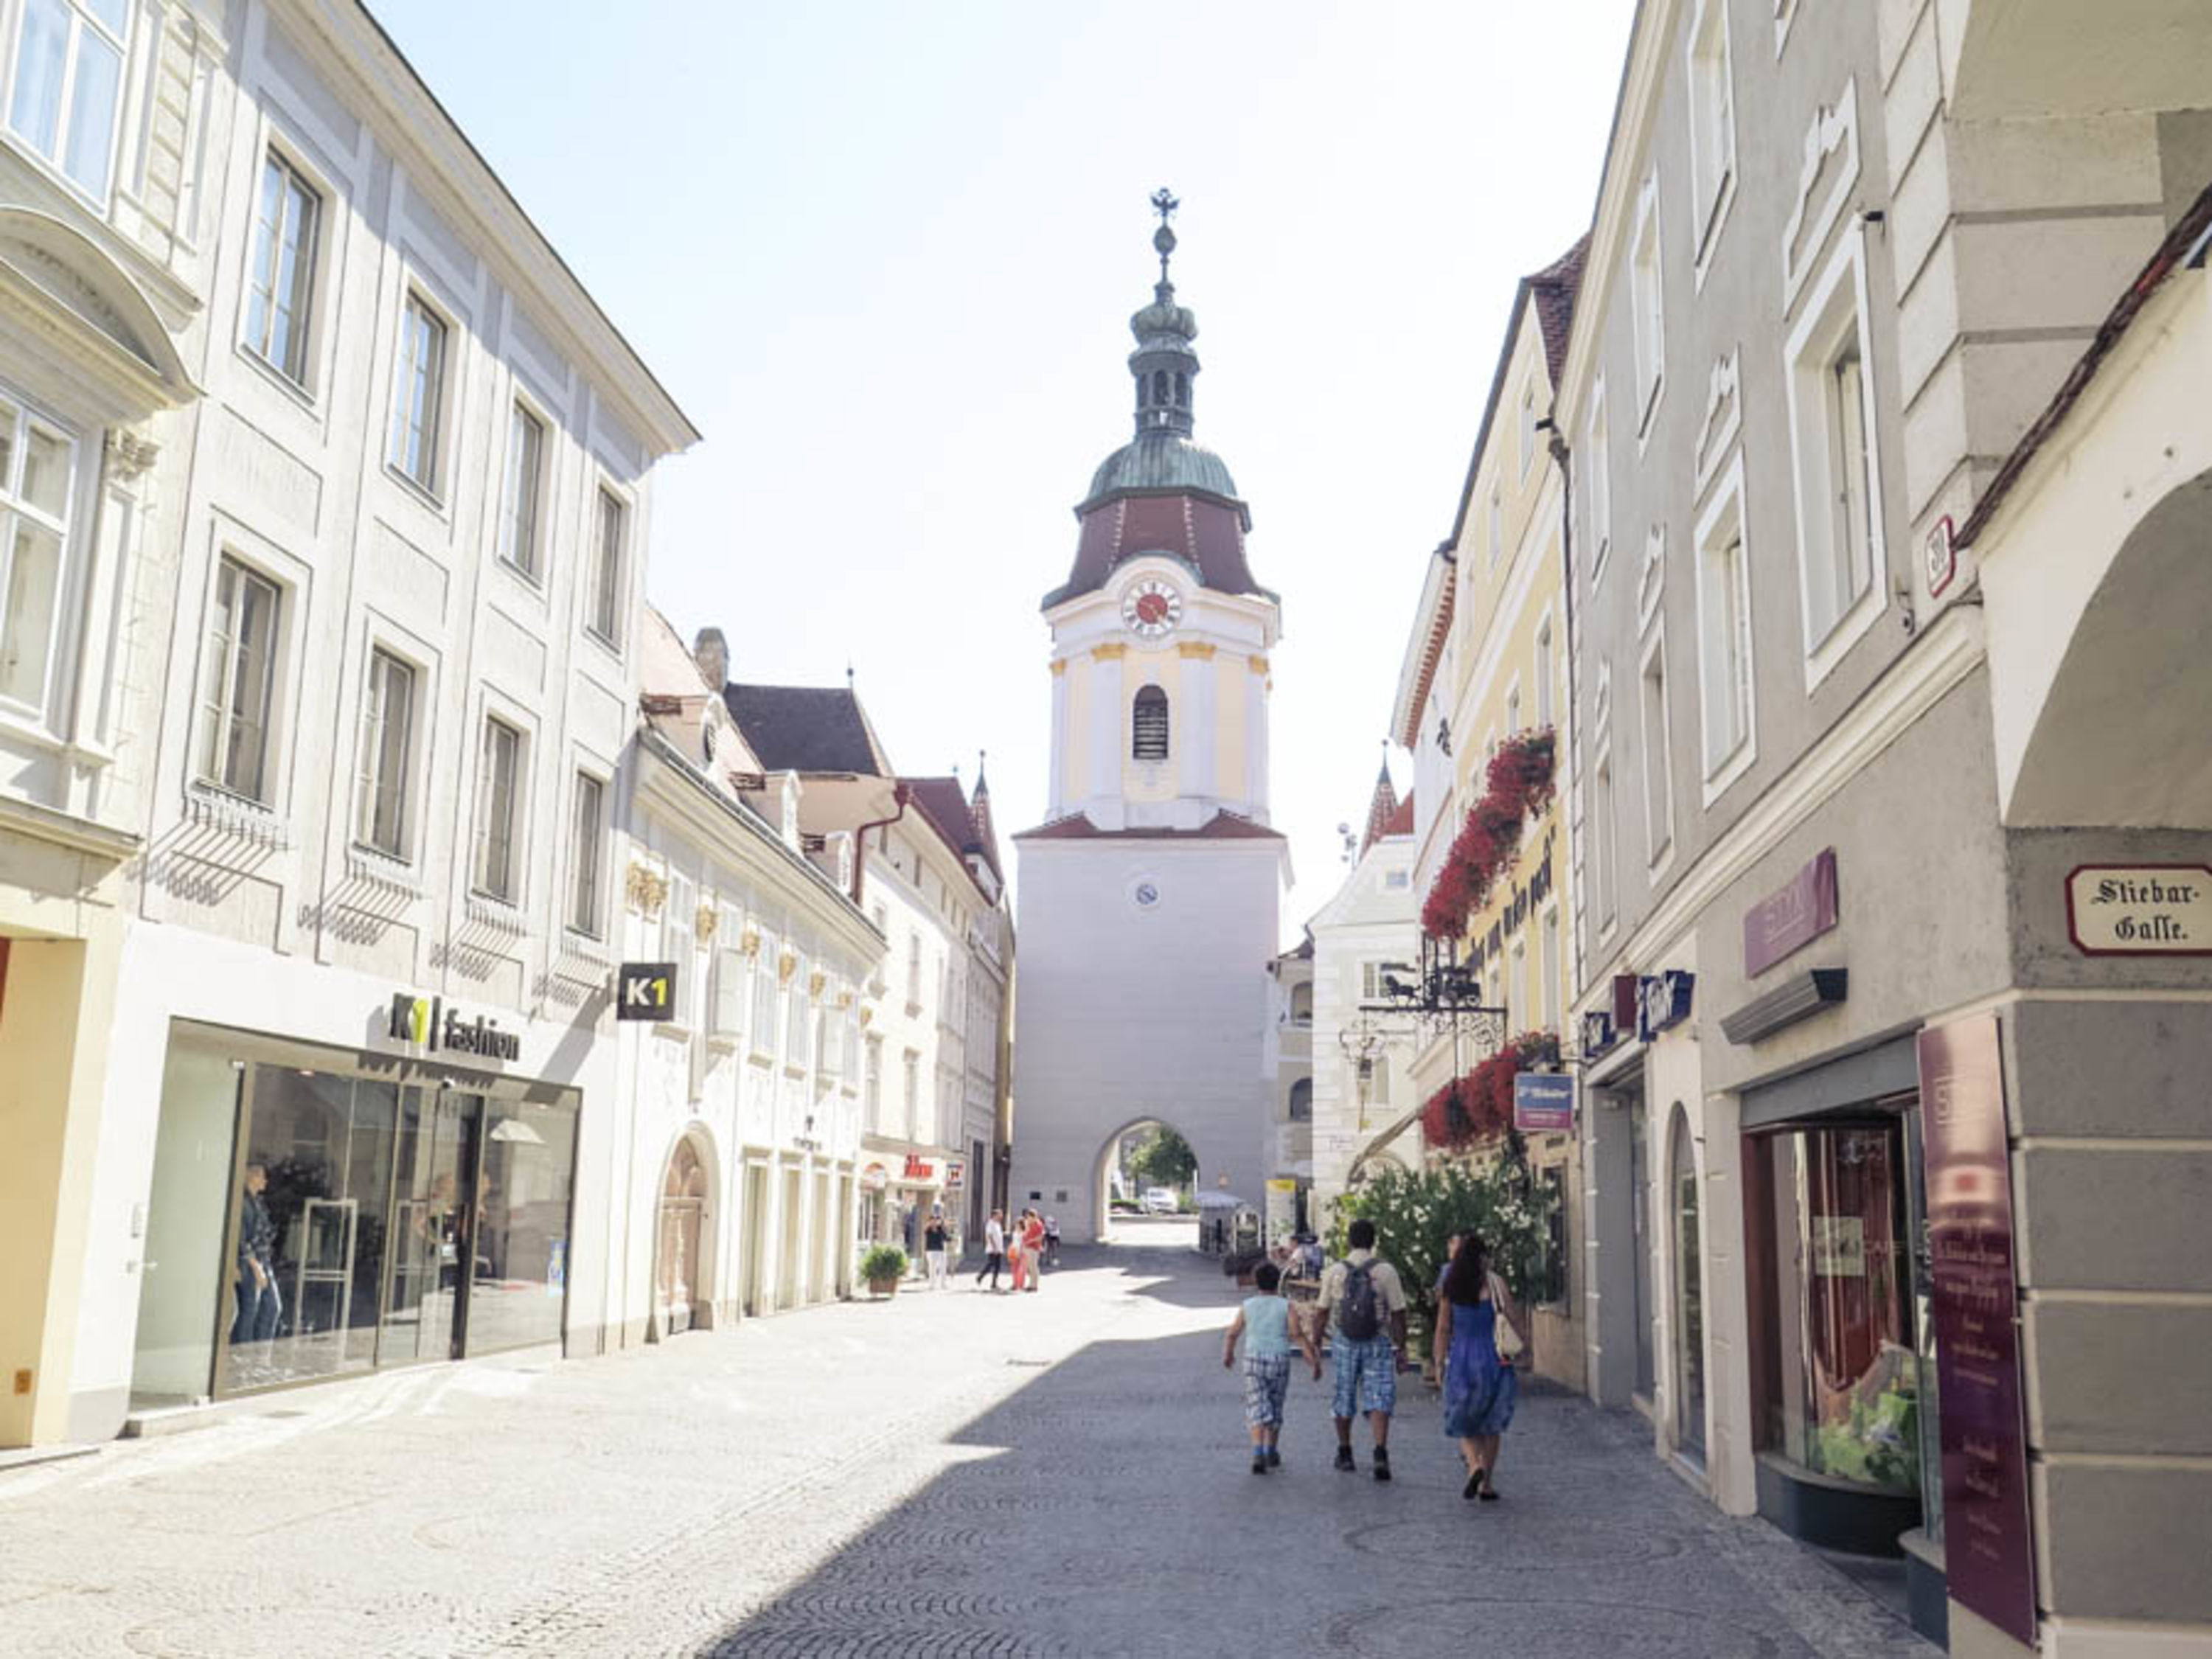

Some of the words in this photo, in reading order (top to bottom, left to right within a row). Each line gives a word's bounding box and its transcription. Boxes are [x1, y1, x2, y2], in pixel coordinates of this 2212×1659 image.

[2091, 878, 2200, 905] Stiebar-
[626, 977, 667, 1006] K1
[390, 992, 429, 1043] K1
[444, 1007, 520, 1062] fashion
